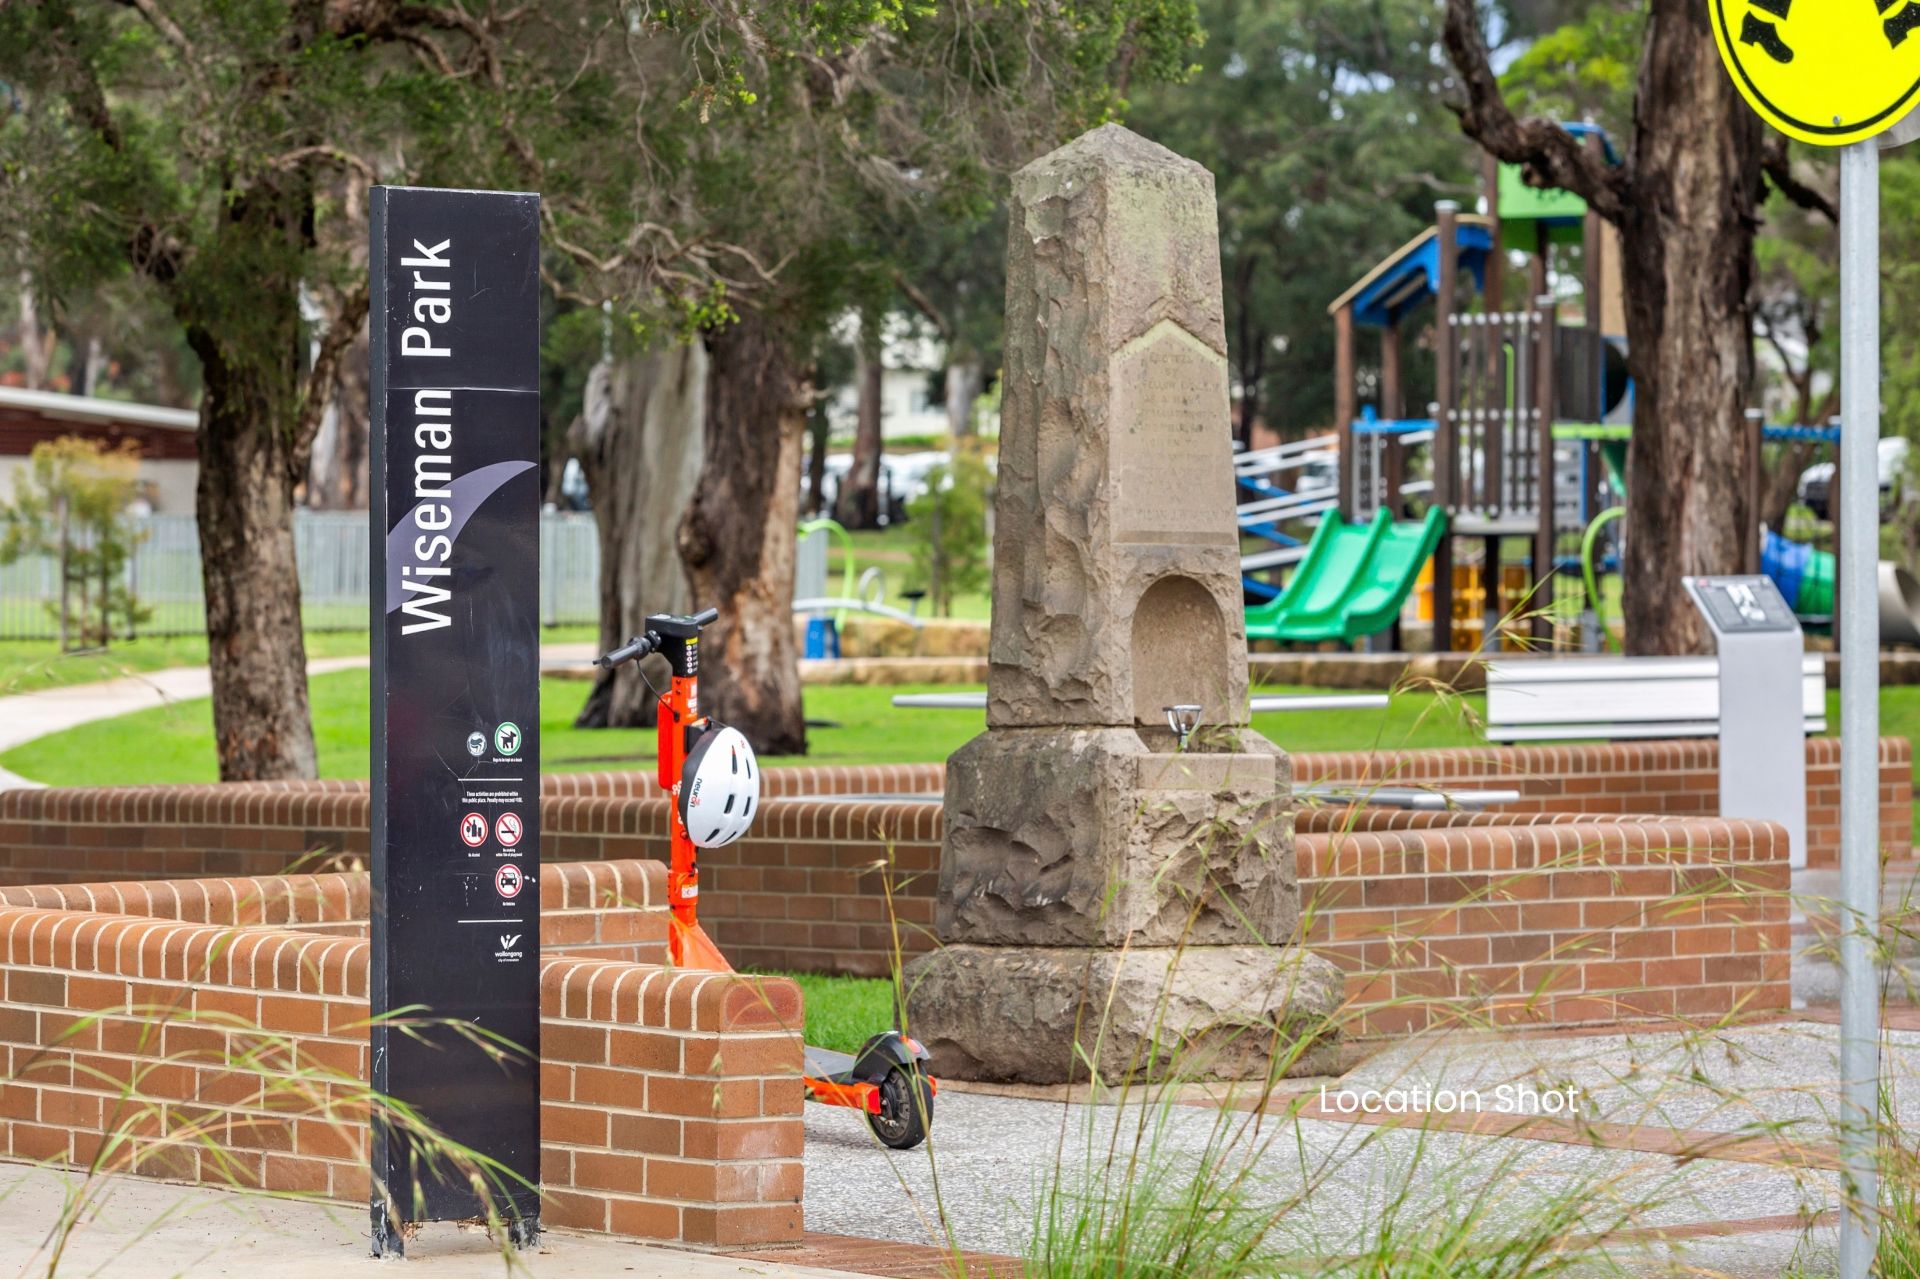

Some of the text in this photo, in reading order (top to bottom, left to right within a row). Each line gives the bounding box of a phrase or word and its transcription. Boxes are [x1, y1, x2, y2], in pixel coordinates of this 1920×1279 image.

[401, 238, 452, 635] Wiseman Park
[690, 778, 702, 806] neuron
